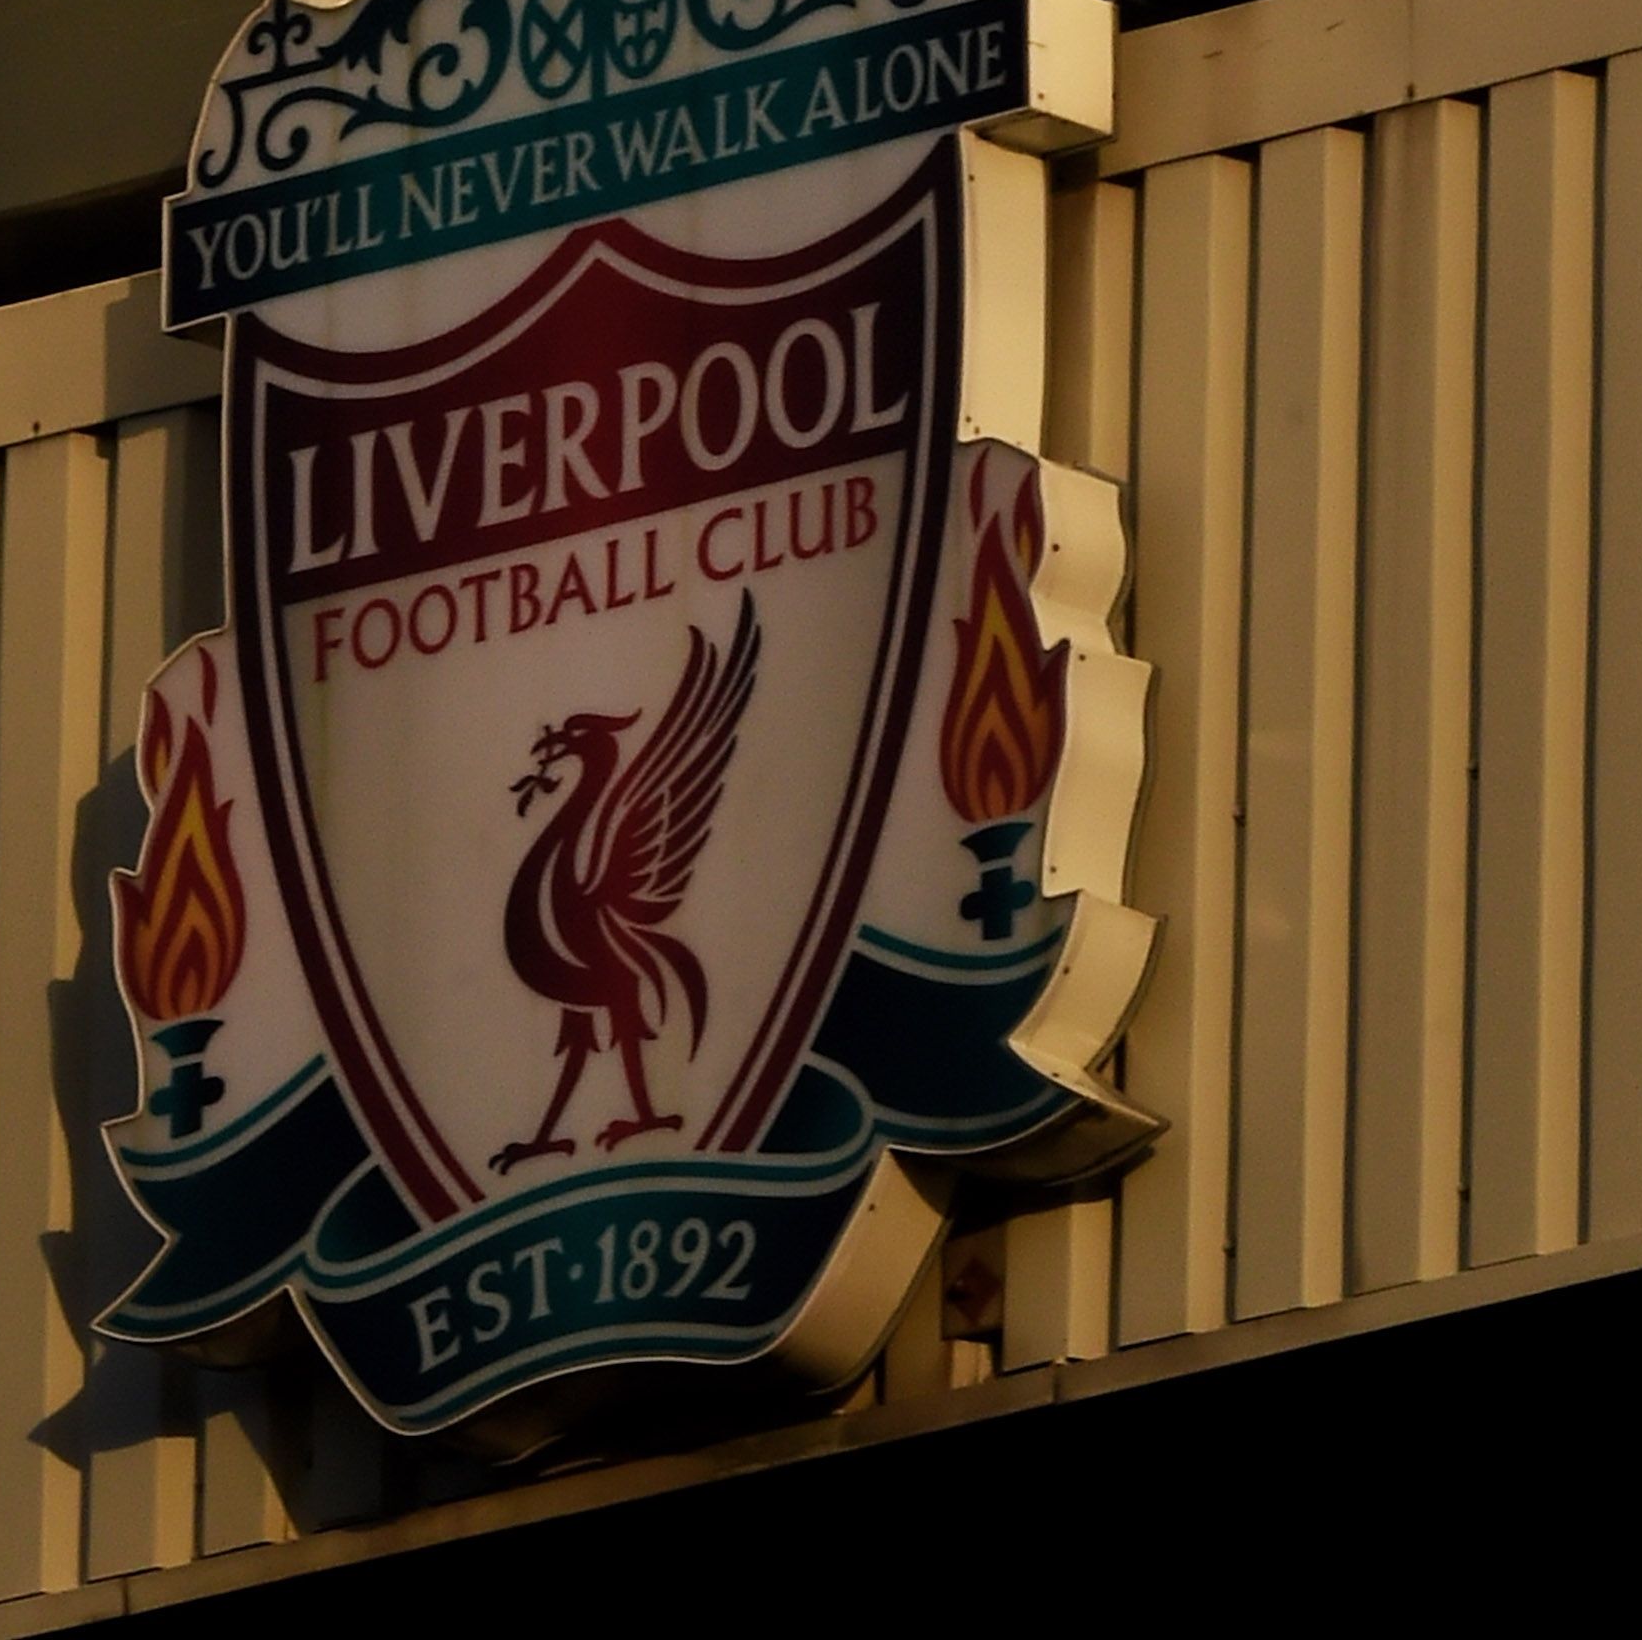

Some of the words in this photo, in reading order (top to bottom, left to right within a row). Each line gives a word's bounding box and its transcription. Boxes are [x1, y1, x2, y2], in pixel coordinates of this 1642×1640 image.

[186, 186, 385, 291] YOU'LL
[396, 129, 601, 240] NEVER
[608, 86, 790, 183] WALK
[798, 21, 1006, 138] ALONE
[289, 302, 908, 573] LIVERPOOL
[313, 529, 675, 682] FOOTBALL
[697, 476, 879, 582] CLUB
